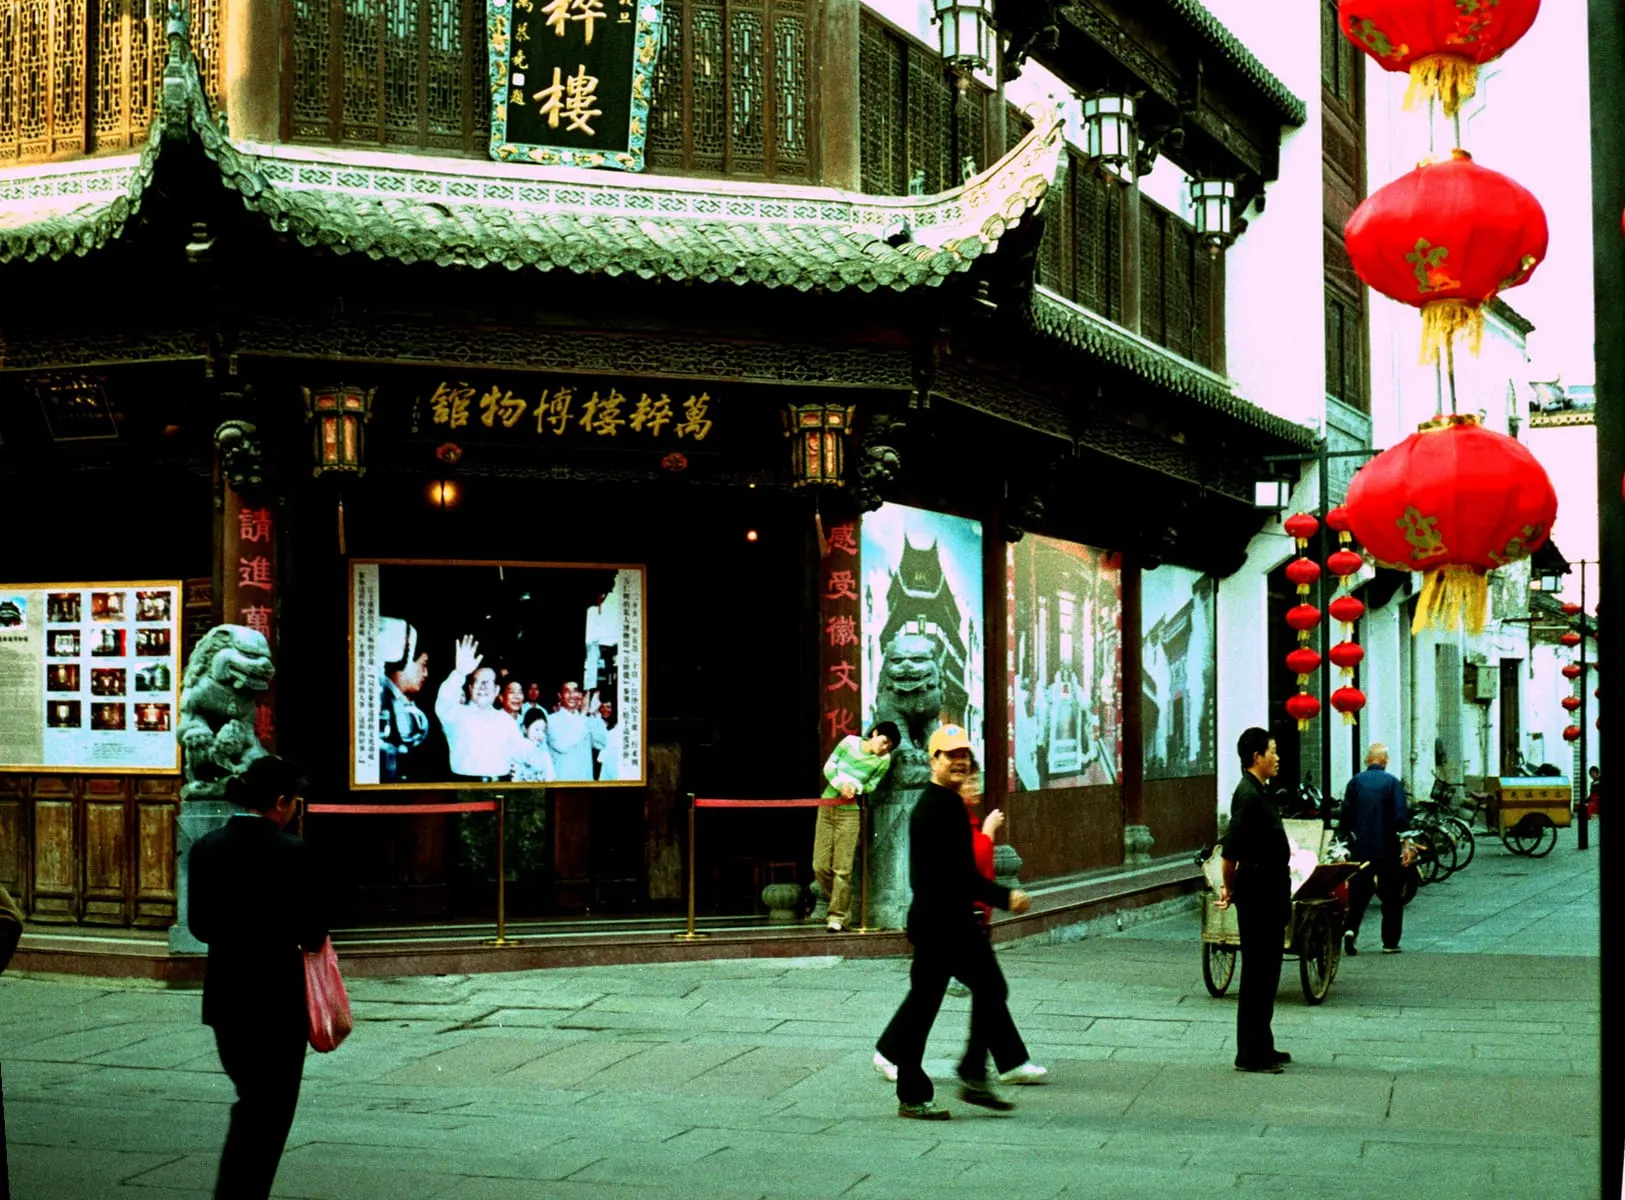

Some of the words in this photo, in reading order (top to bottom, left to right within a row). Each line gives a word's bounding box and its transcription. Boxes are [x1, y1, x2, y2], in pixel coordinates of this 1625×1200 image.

[826, 524, 860, 737] 感受徽文化
